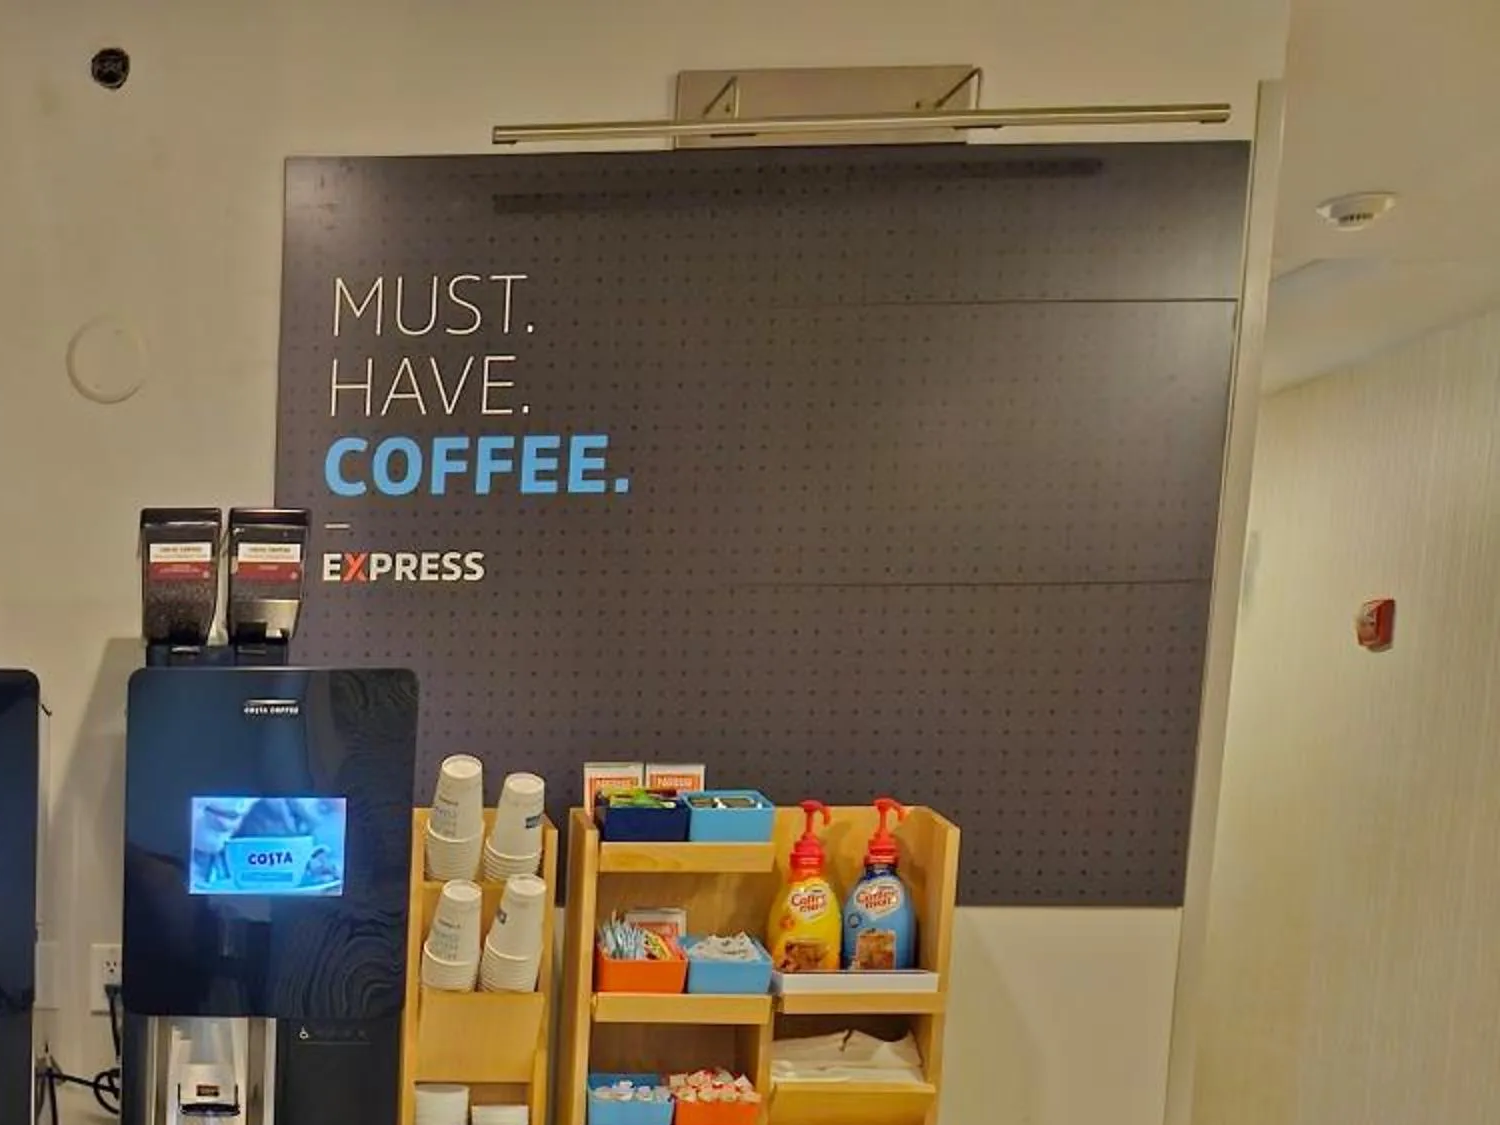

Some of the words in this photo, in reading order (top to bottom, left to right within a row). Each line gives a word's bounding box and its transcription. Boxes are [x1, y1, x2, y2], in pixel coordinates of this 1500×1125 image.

[333, 275, 534, 336] MUST.
[330, 355, 529, 417] HAVE.
[324, 434, 629, 496] COFFEE.
[322, 552, 485, 581] EXPRESS
[248, 852, 293, 866] COSTA
